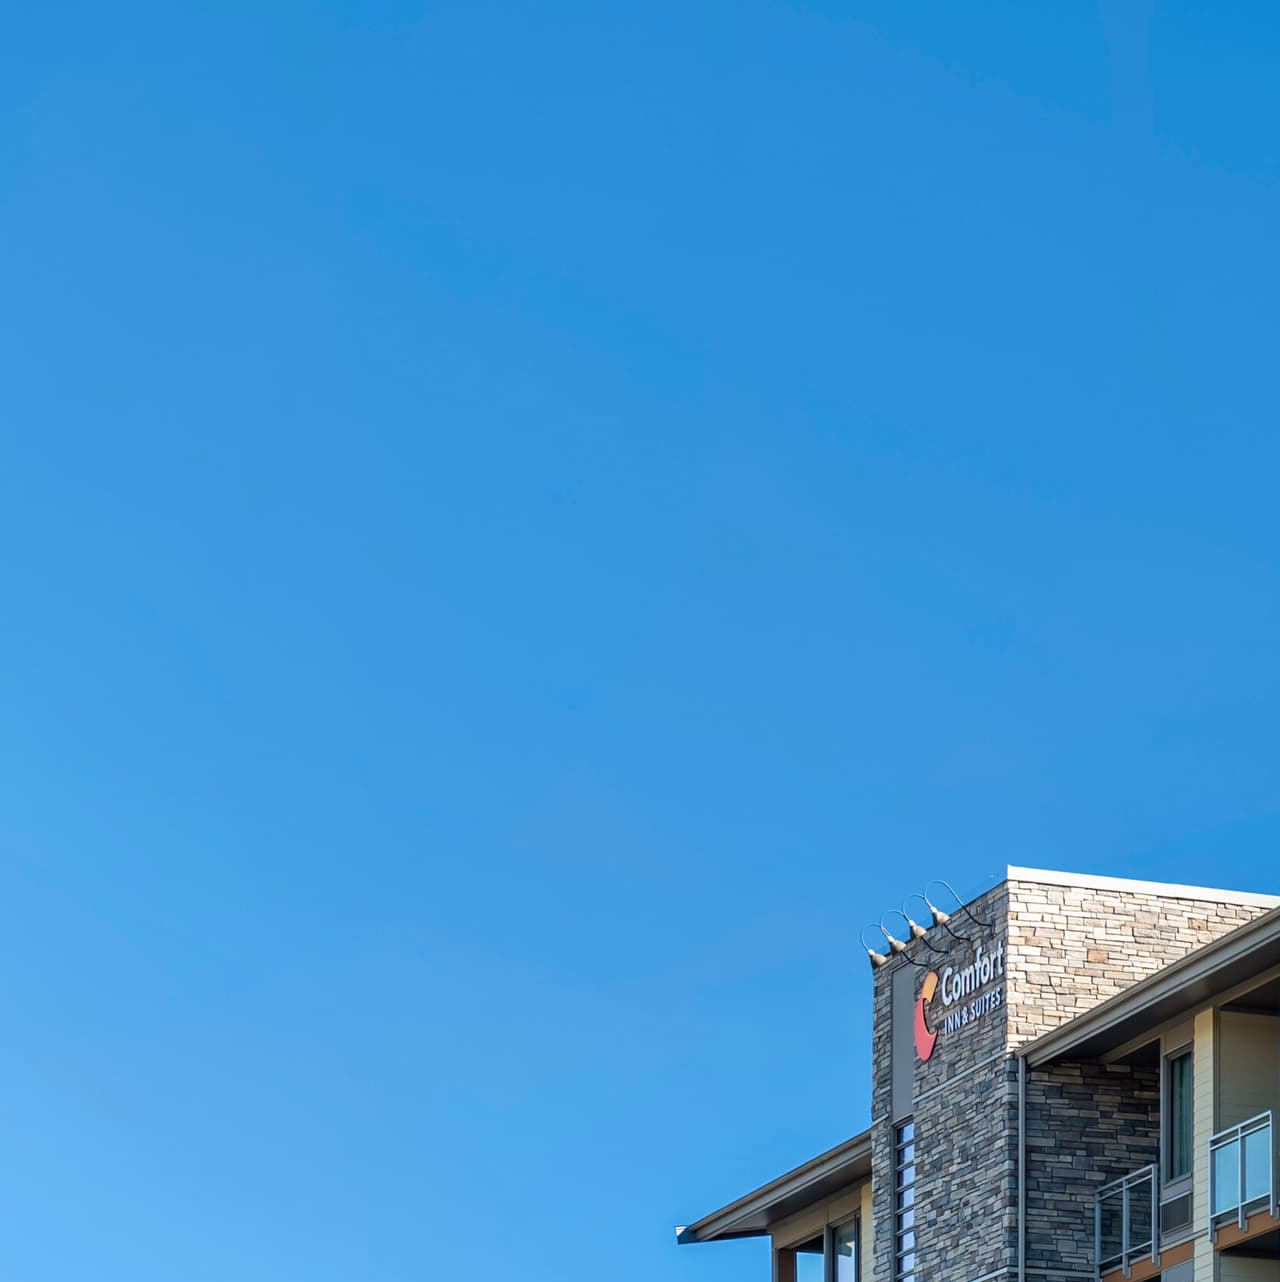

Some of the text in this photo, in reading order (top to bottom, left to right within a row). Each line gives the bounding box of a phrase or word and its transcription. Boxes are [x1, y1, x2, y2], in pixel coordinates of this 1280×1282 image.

[942, 940, 1004, 1006] Comfort
[944, 987, 1001, 1036] INN & SUITES
